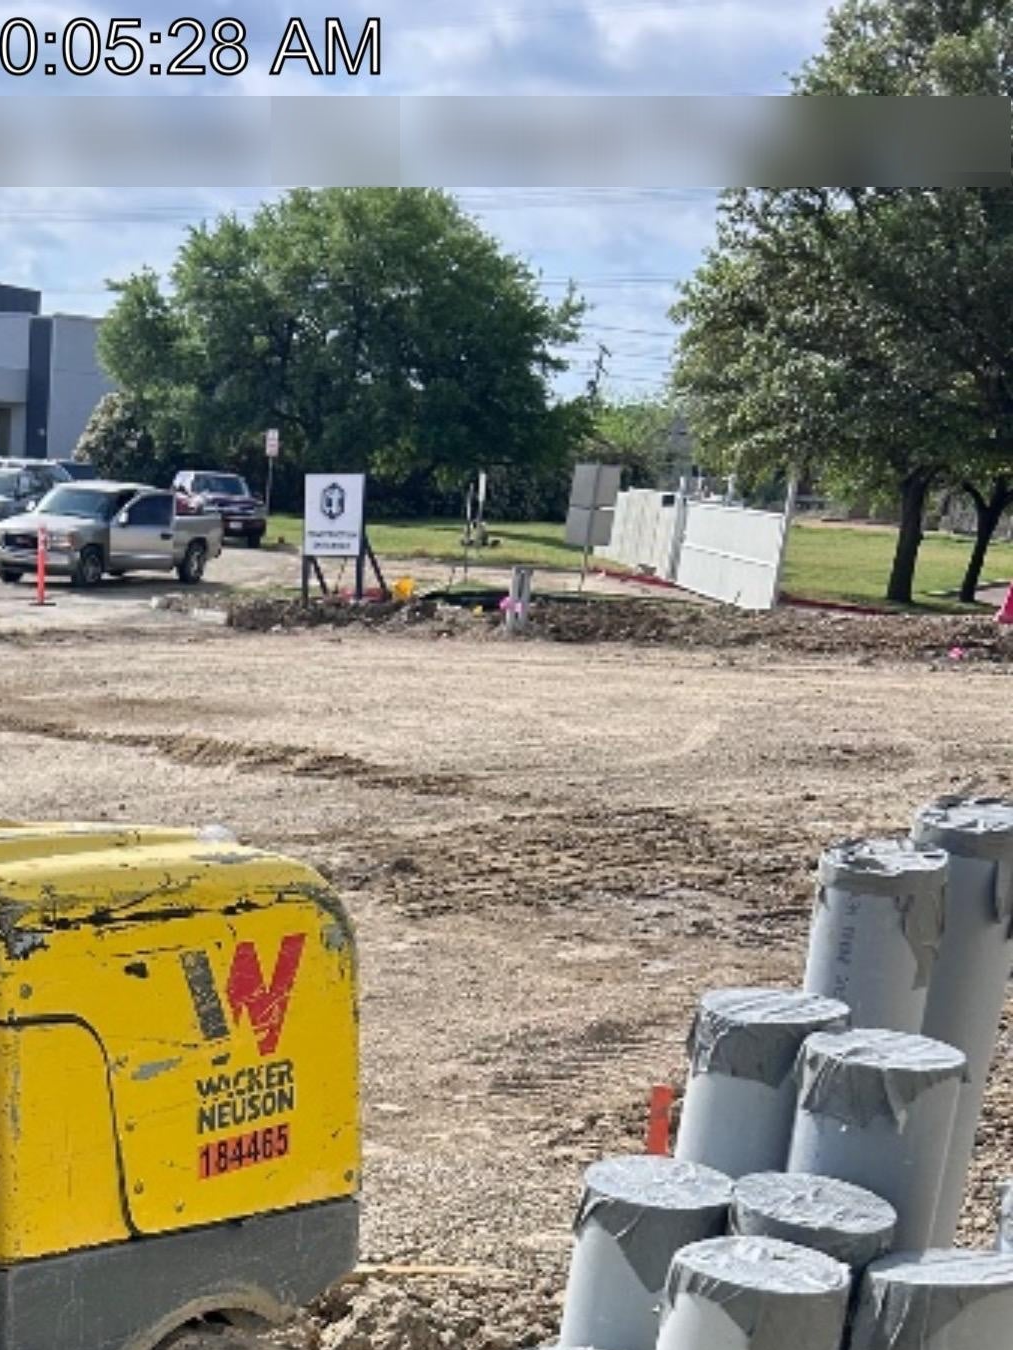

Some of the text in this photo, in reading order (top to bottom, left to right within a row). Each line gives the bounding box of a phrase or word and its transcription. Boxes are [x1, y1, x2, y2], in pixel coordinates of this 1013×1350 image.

[196, 1058, 294, 1098] WACKER
[197, 1086, 294, 1134] NEUSON
[201, 1124, 288, 1177] 184465
